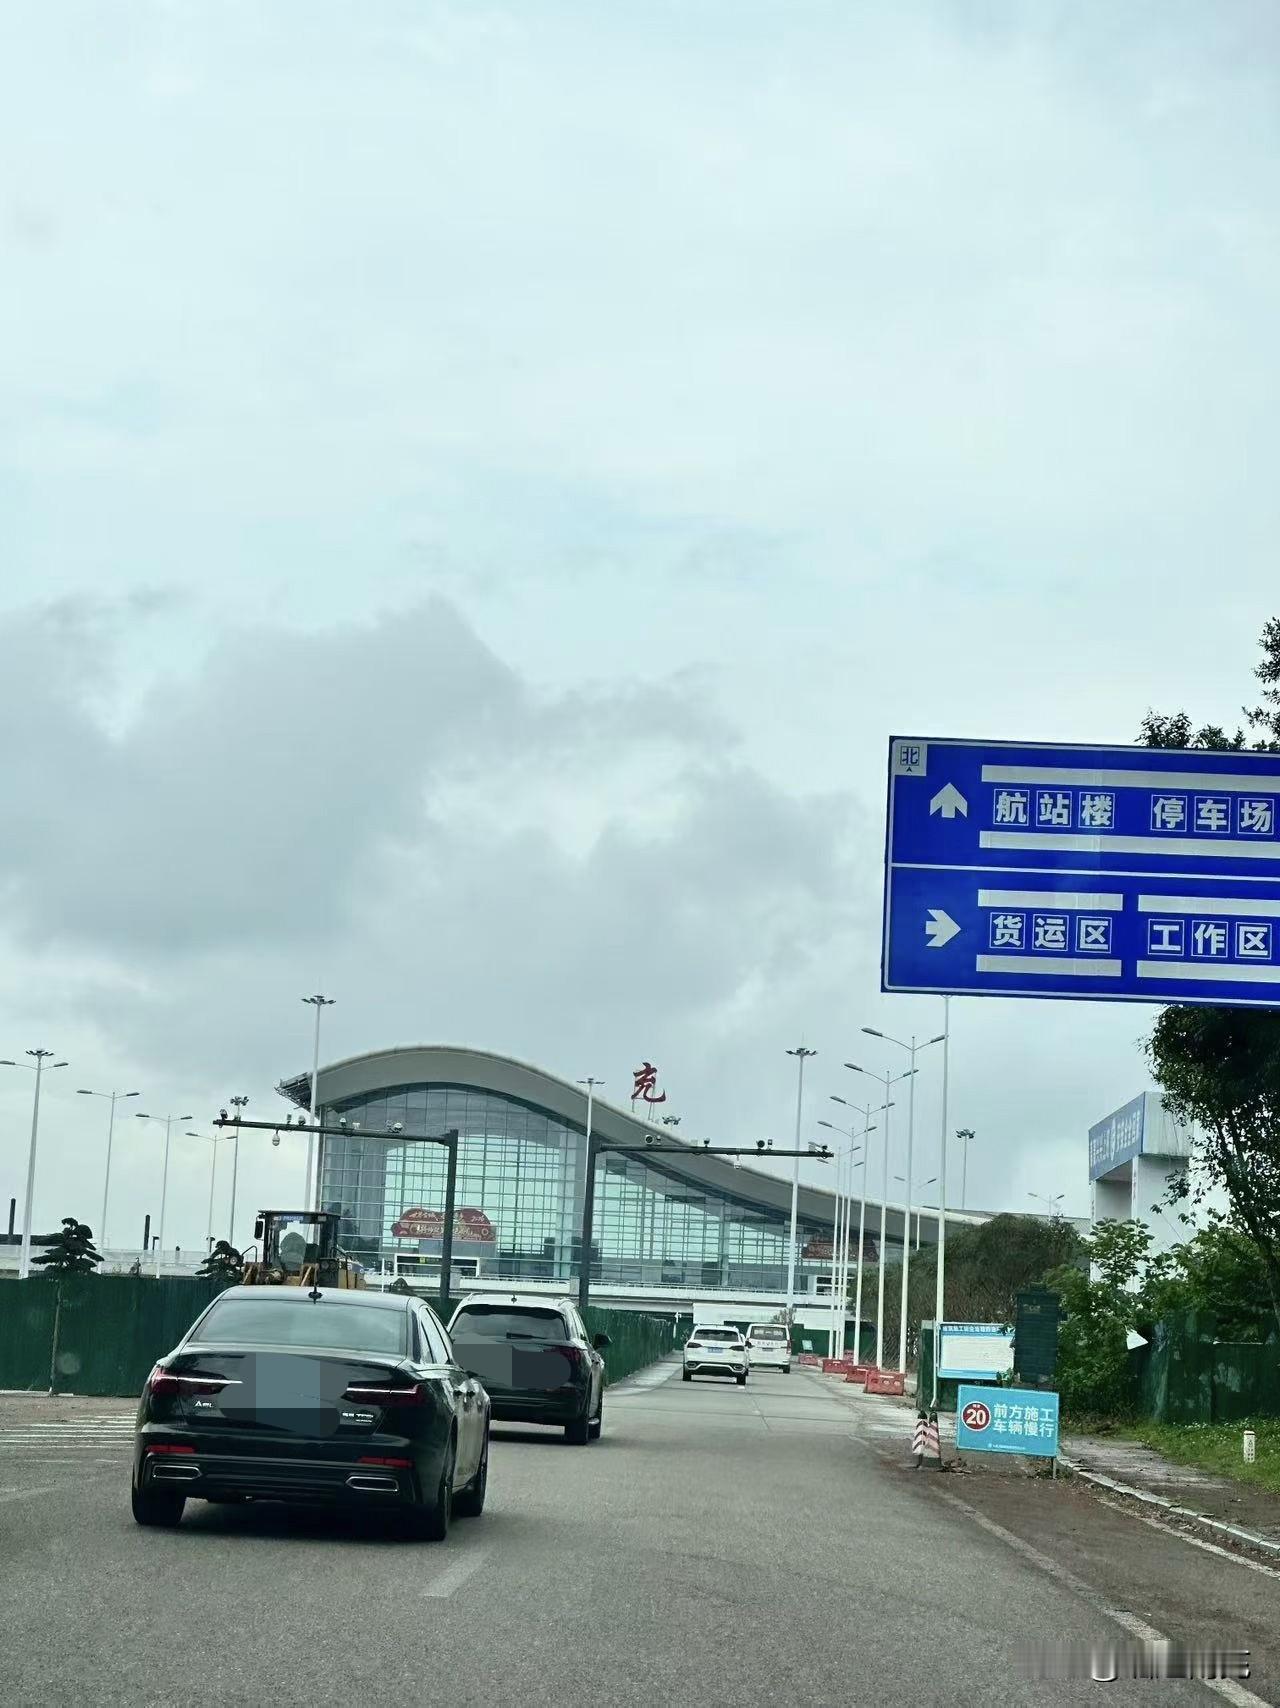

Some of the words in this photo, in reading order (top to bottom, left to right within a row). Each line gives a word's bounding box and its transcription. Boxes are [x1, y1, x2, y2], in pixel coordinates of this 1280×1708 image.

[902, 747, 918, 765] 北
[996, 792, 1113, 826] 航站楼
[1153, 798, 1273, 832] 停车场
[993, 914, 1109, 950] 货运区
[1150, 923, 1269, 956] 工作区
[631, 1062, 666, 1102] 充
[966, 1408, 986, 1425] 20
[993, 1403, 1054, 1422] 前方施工
[993, 1418, 1054, 1437] 车辆慢行
